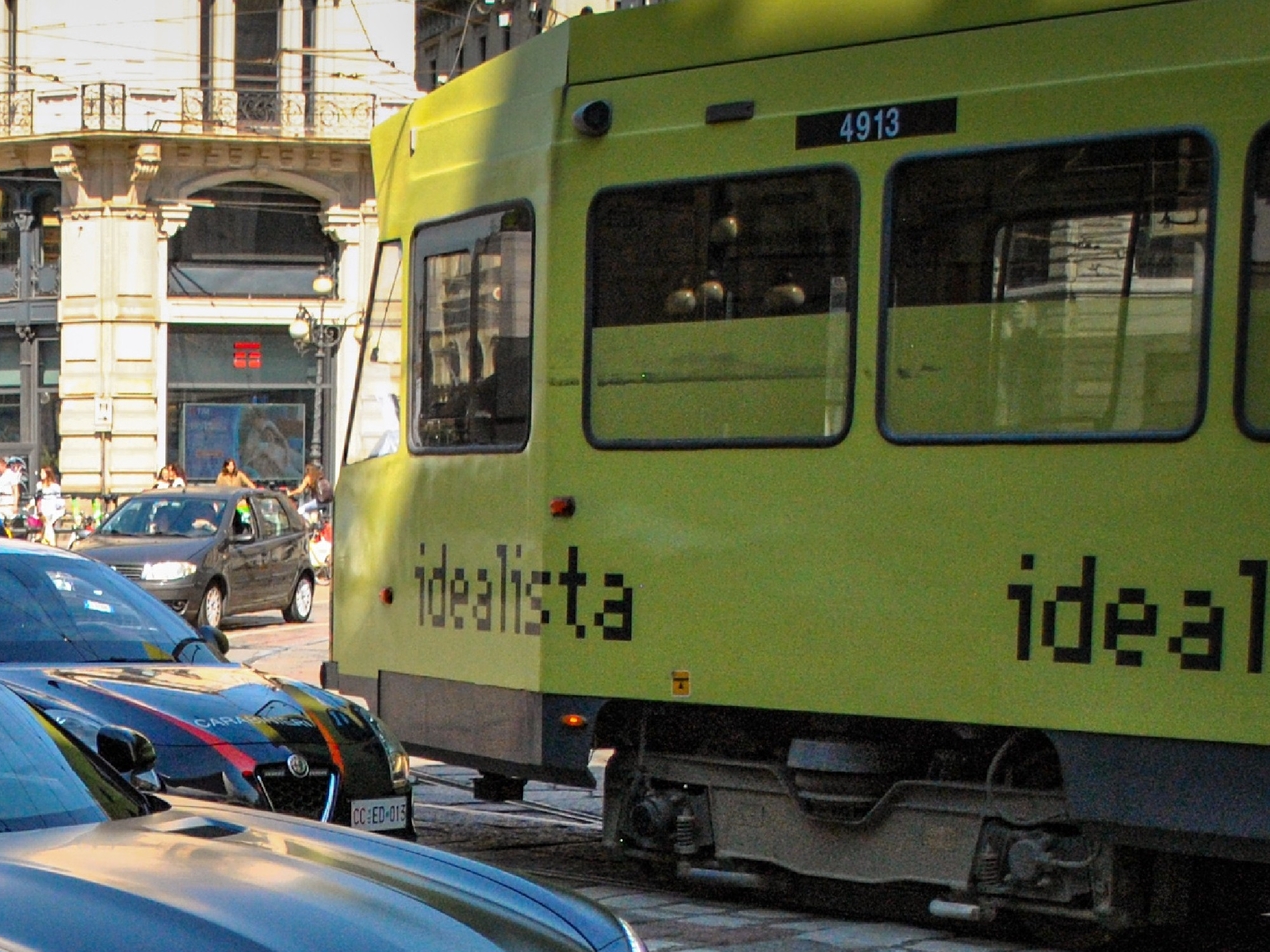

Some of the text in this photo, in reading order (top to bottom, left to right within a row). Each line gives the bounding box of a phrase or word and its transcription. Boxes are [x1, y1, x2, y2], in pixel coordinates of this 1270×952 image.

[839, 106, 900, 143] 4913
[414, 542, 634, 642] idealista
[1007, 553, 1269, 675] ideal
[353, 806, 366, 825] CC
